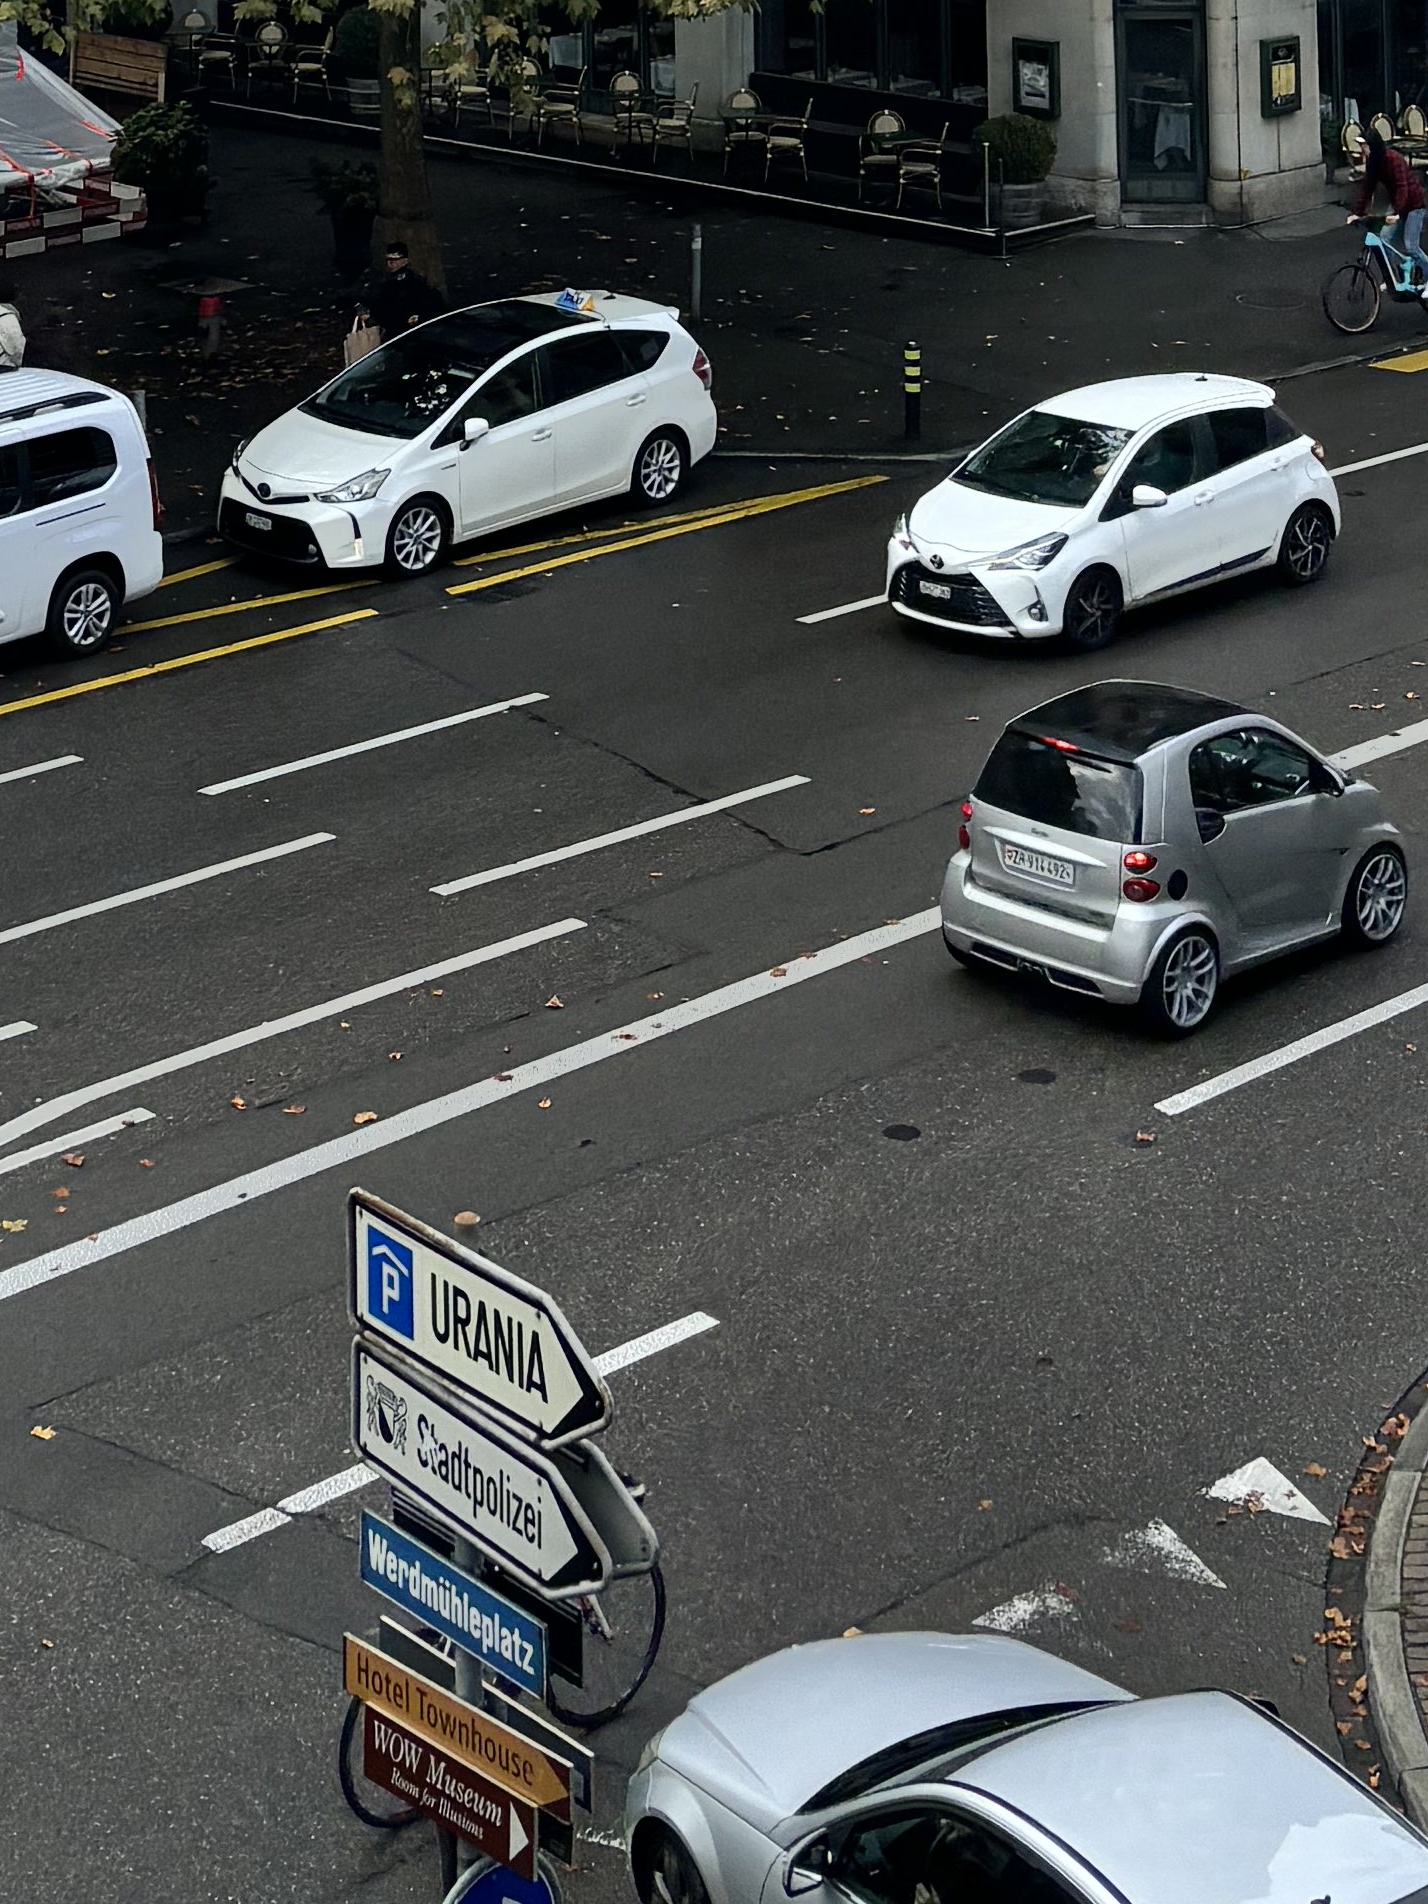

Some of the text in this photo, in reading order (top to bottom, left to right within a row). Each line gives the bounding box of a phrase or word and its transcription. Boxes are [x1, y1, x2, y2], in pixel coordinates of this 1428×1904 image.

[431, 1272, 549, 1404] URANIA
[417, 1413, 542, 1550] Stadtpolizei
[368, 1528, 535, 1676] Werdmühleplatz
[357, 1652, 534, 1786] Hotel Townhouse
[373, 1720, 502, 1828] WOW Museum
[391, 1767, 484, 1840] Room for Illusions
